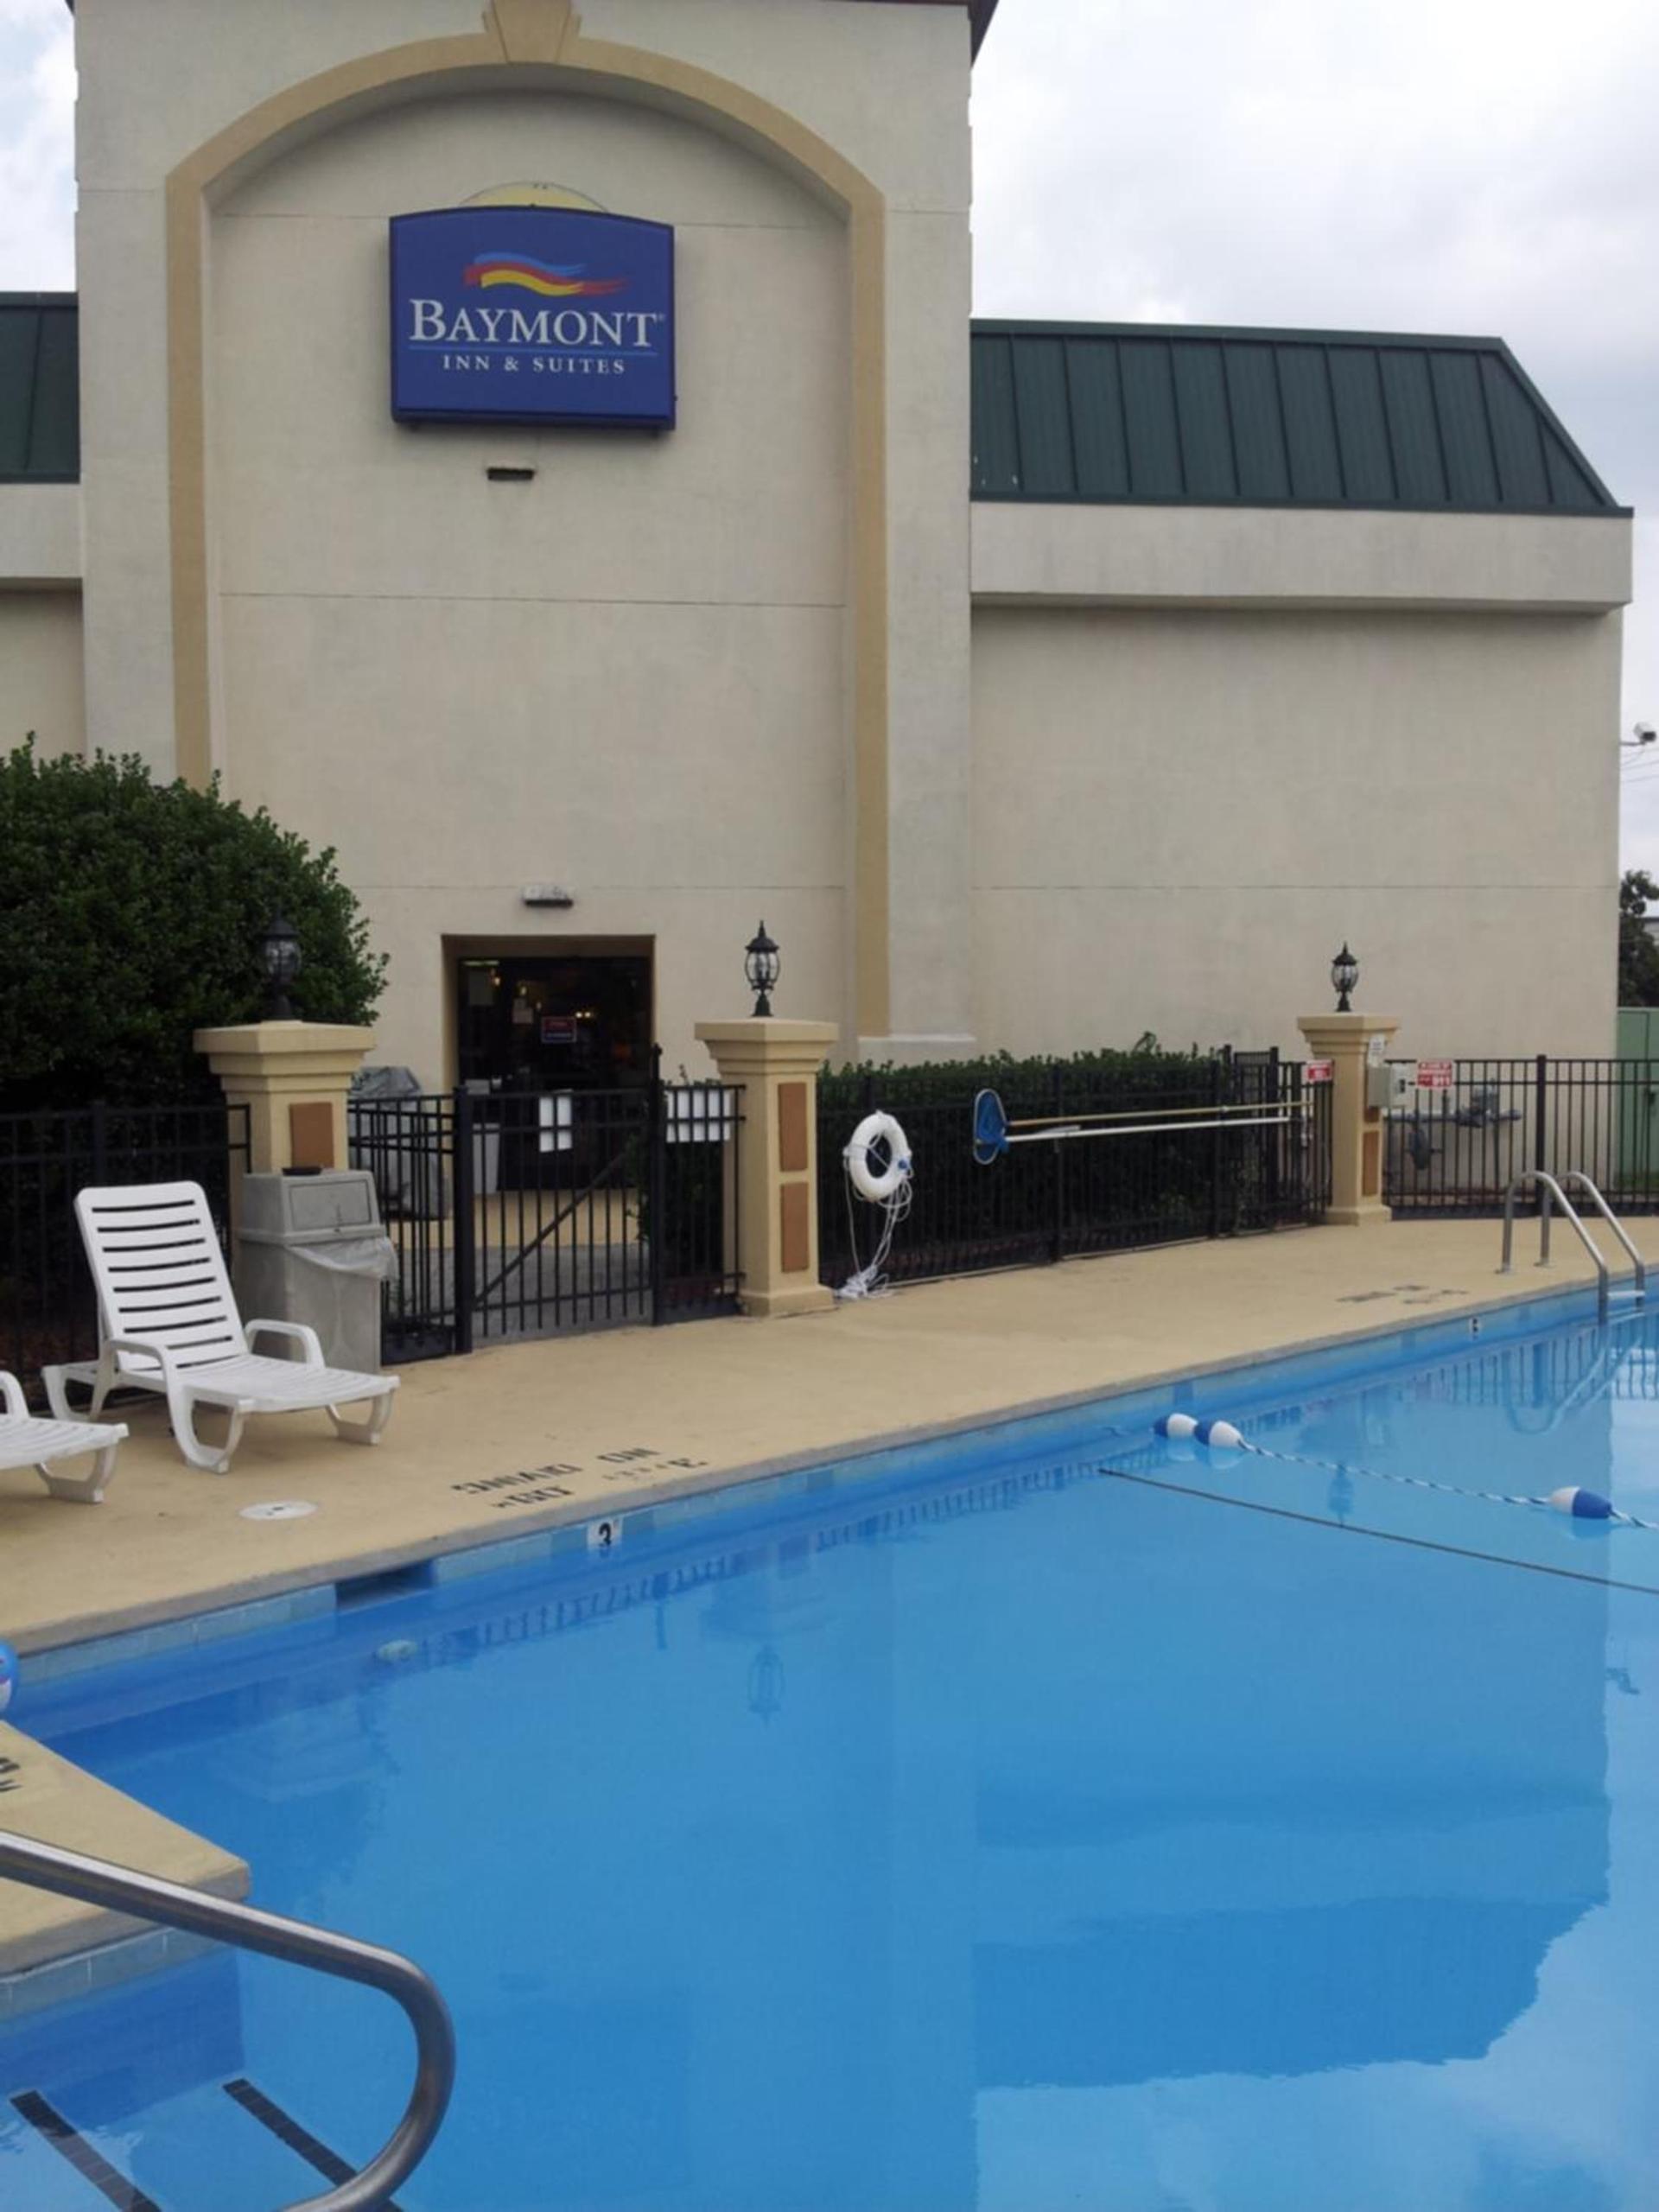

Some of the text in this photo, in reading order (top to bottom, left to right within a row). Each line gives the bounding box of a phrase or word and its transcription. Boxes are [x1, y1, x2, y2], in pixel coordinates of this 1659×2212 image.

[409, 299, 658, 348] BAYMONT
[443, 355, 626, 374] INN & SUITES
